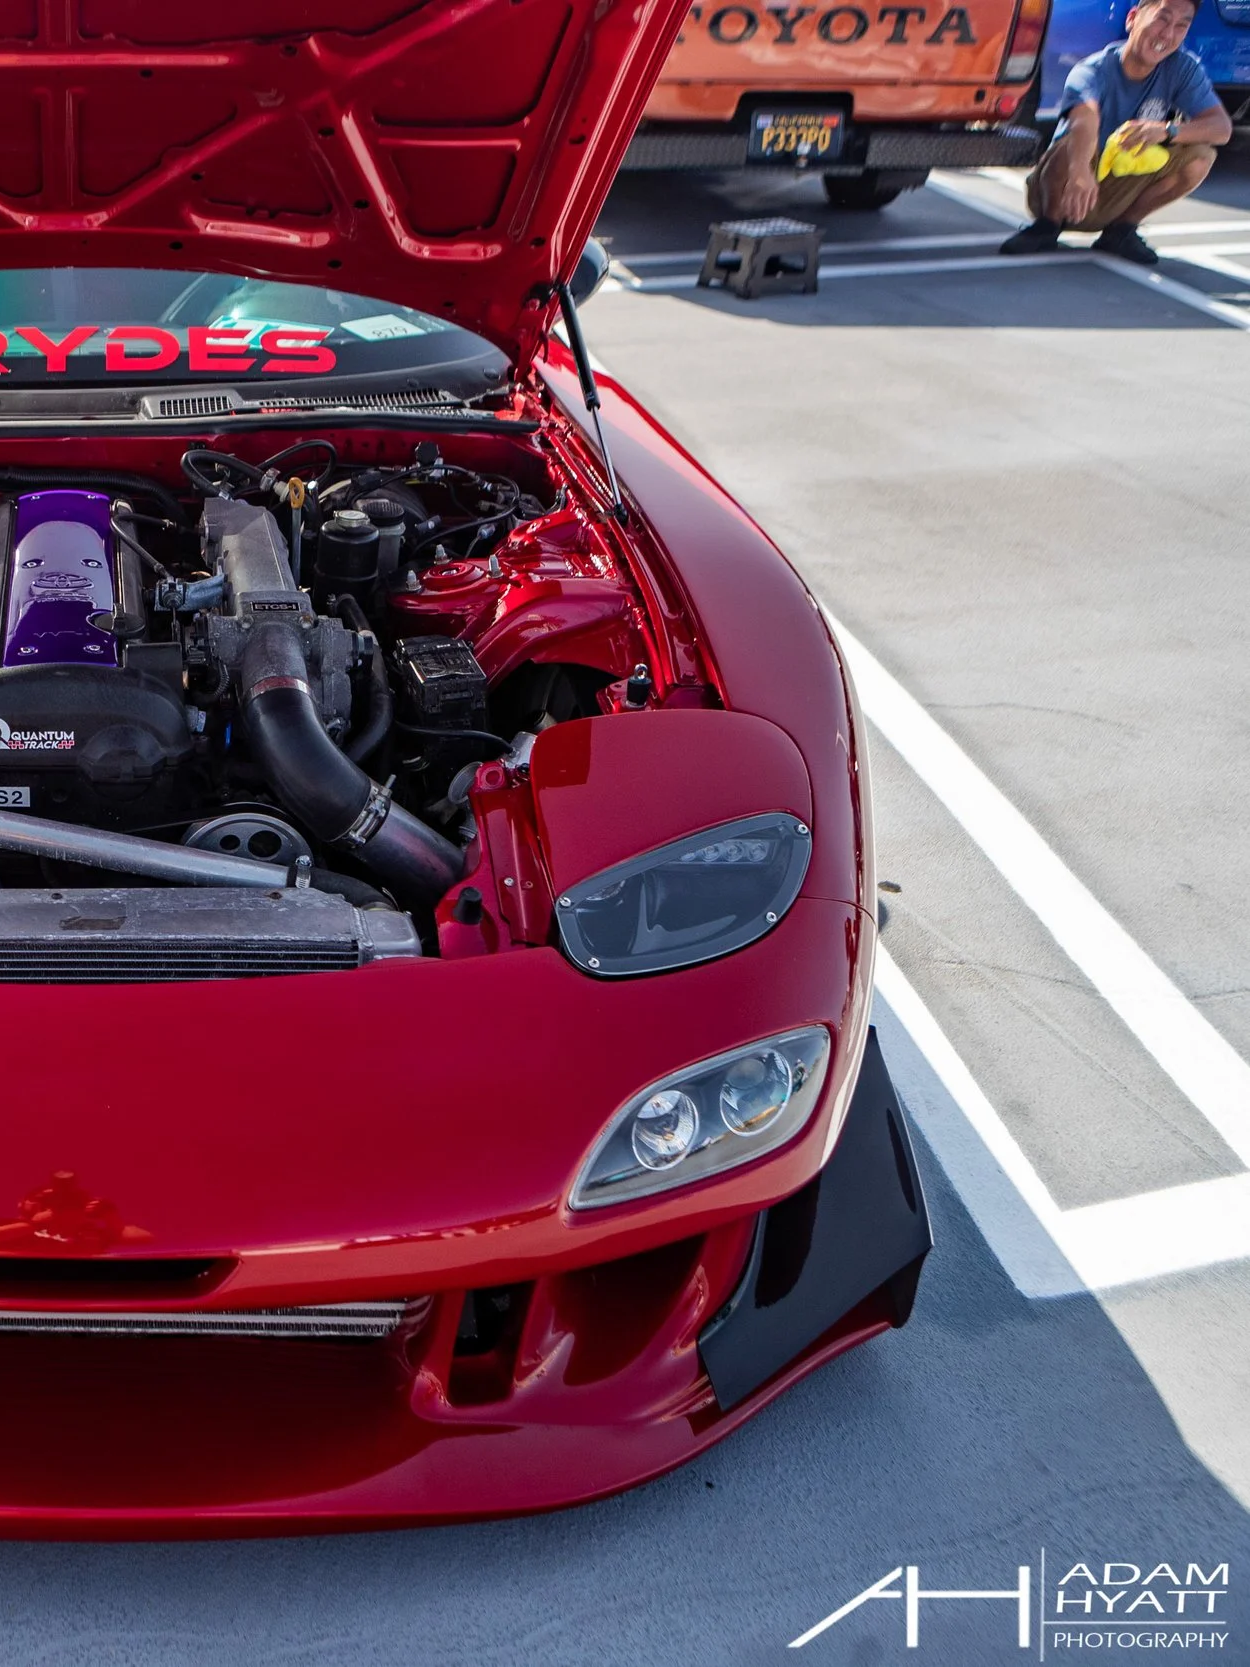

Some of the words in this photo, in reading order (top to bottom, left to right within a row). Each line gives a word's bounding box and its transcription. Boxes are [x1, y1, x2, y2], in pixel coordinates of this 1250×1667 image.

[677, 6, 978, 45] OYOTA
[11, 731, 75, 741] QUANTUM
[23, 740, 59, 750] TRACK
